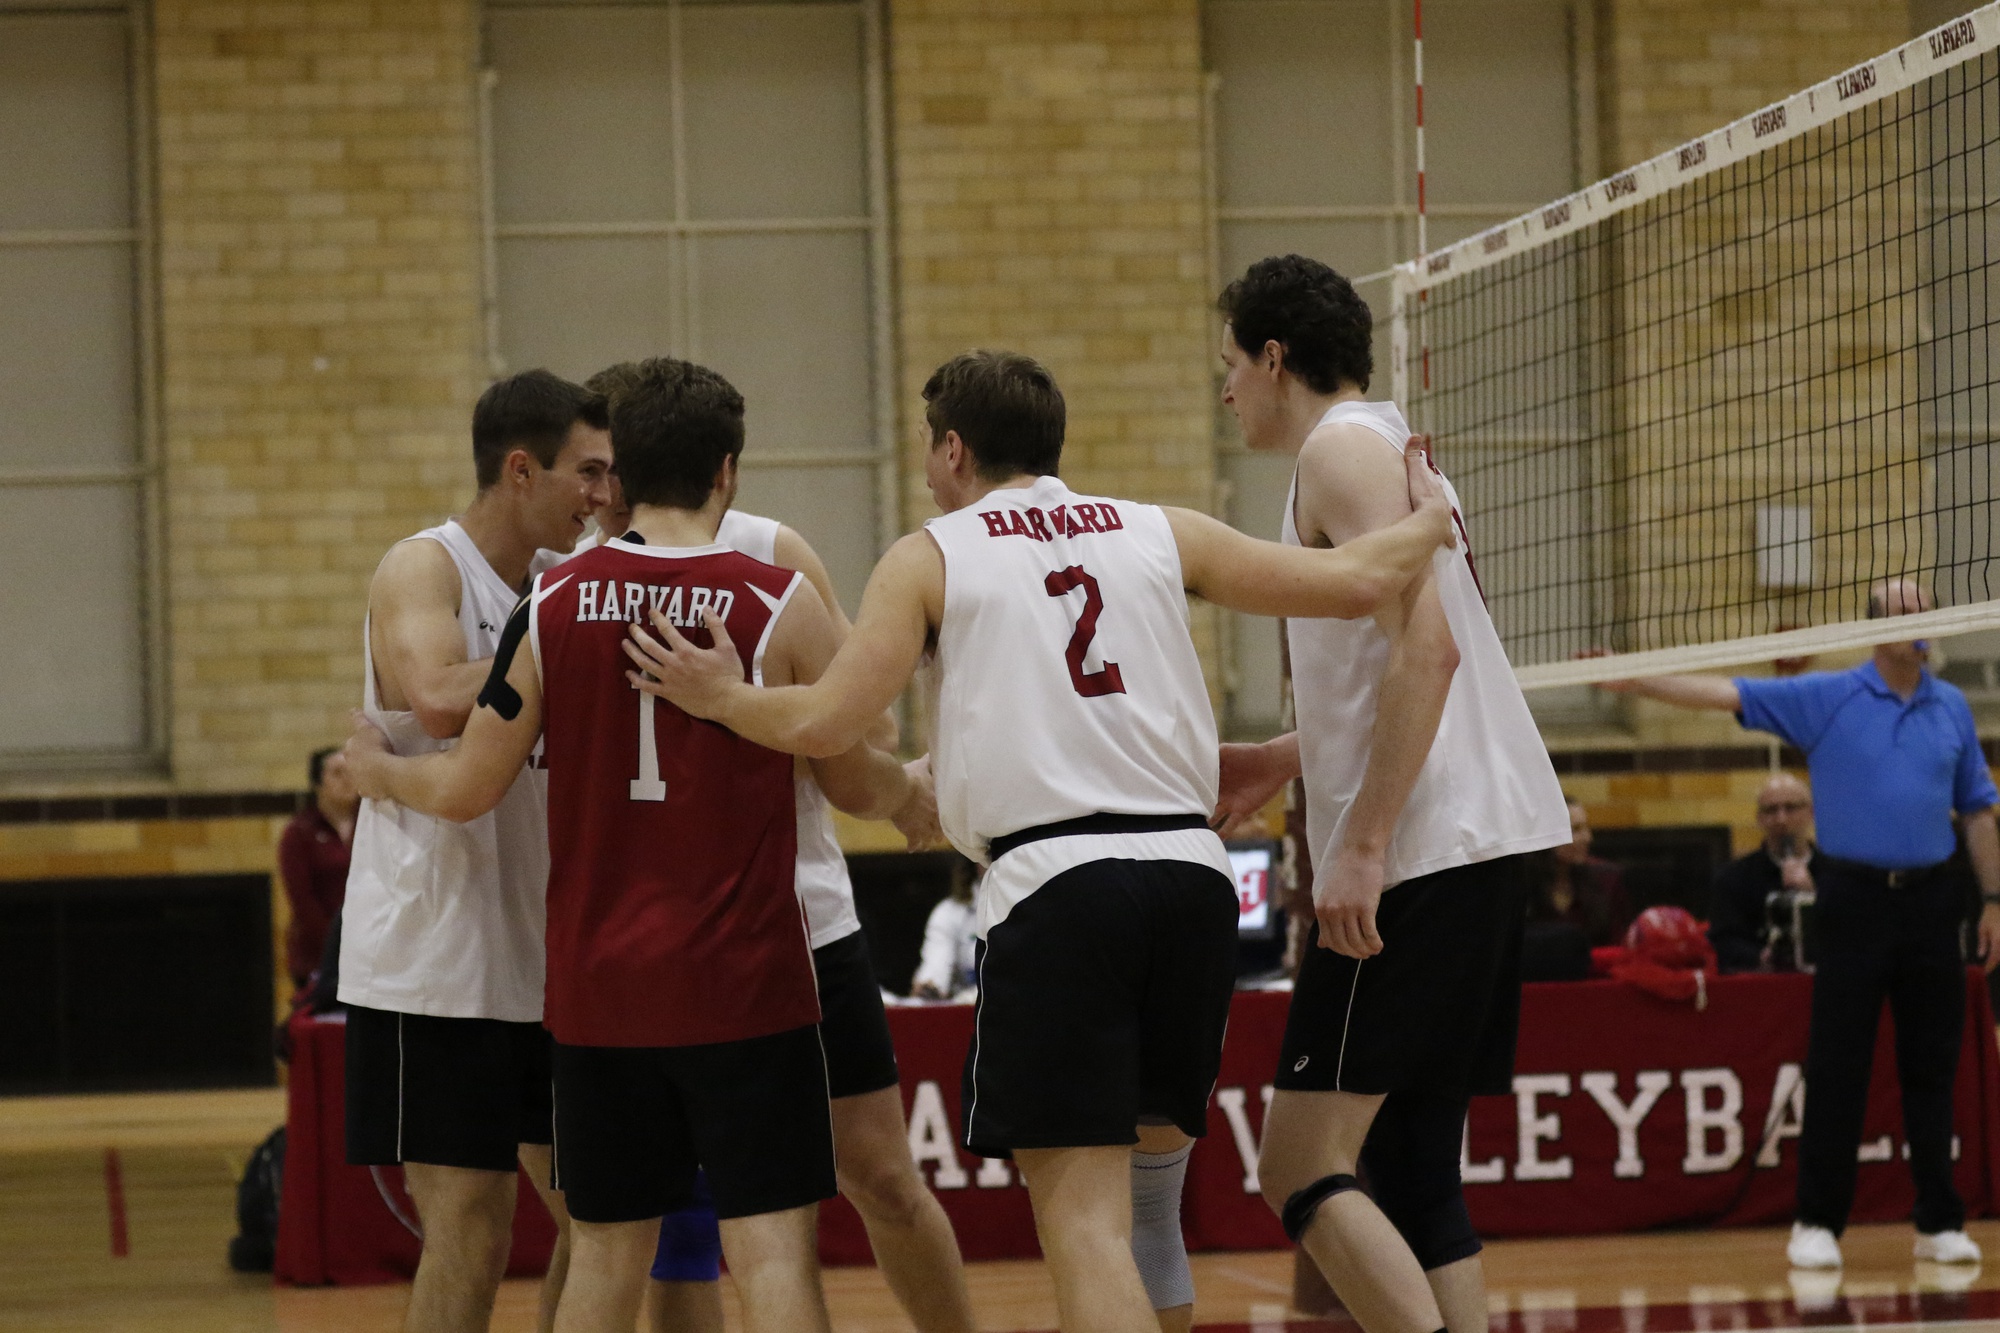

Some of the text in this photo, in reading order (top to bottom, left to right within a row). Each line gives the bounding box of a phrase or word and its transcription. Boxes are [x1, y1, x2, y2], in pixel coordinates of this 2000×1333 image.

[977, 502, 1124, 543] HARVARD
[576, 579, 735, 629] HARVARD
[1043, 564, 1128, 698] 2
[629, 668, 667, 802] 1
[1216, 1062, 1962, 1196] VLEYBA
